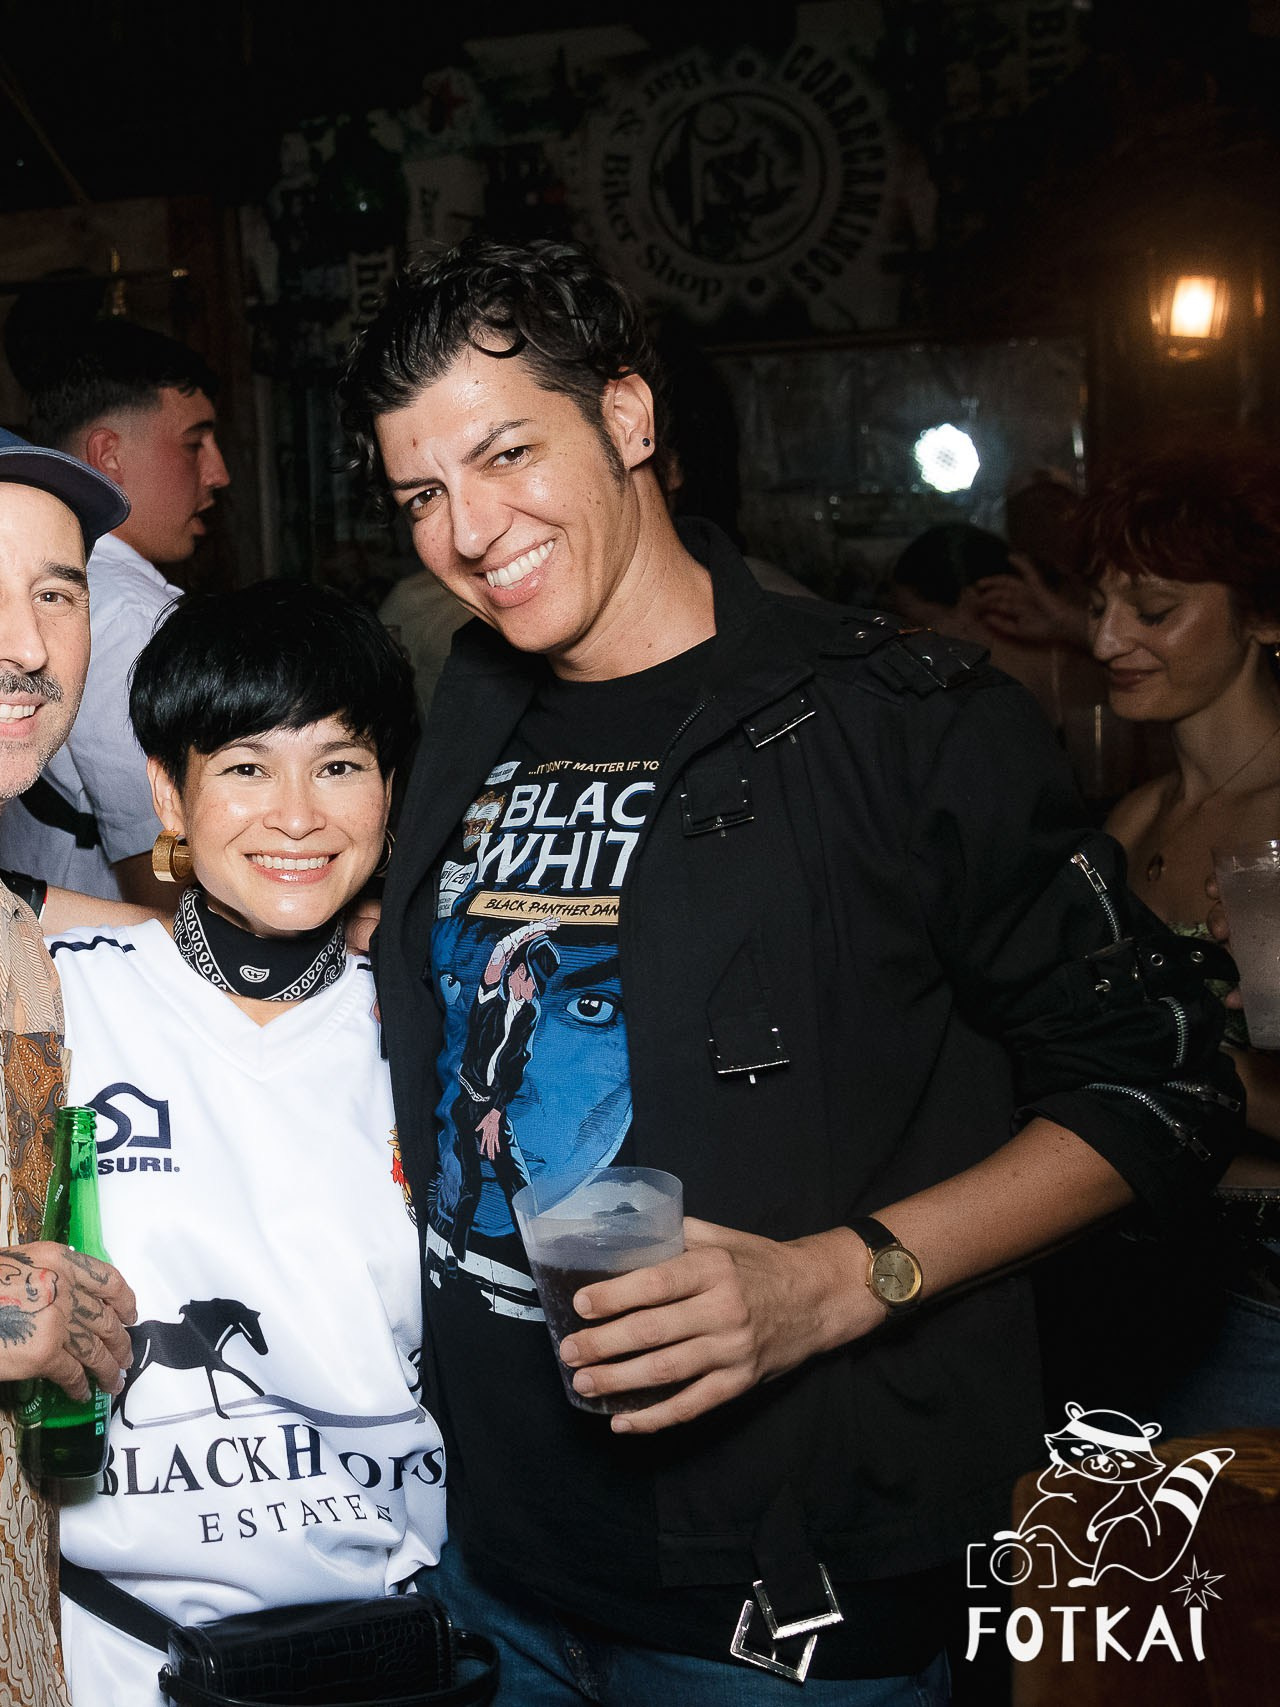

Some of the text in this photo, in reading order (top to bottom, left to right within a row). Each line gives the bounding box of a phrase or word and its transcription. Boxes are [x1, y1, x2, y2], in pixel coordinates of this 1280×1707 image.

[782, 45, 887, 295] CORRECAMINOS
[602, 153, 638, 243] Biker
[645, 244, 722, 303] Shop
[546, 761, 573, 773] DON'T
[572, 761, 625, 773] MATTER
[626, 761, 640, 771] IF
[500, 781, 657, 829] BLAC
[484, 898, 527, 912] BLACK
[528, 901, 589, 917] PANTHER
